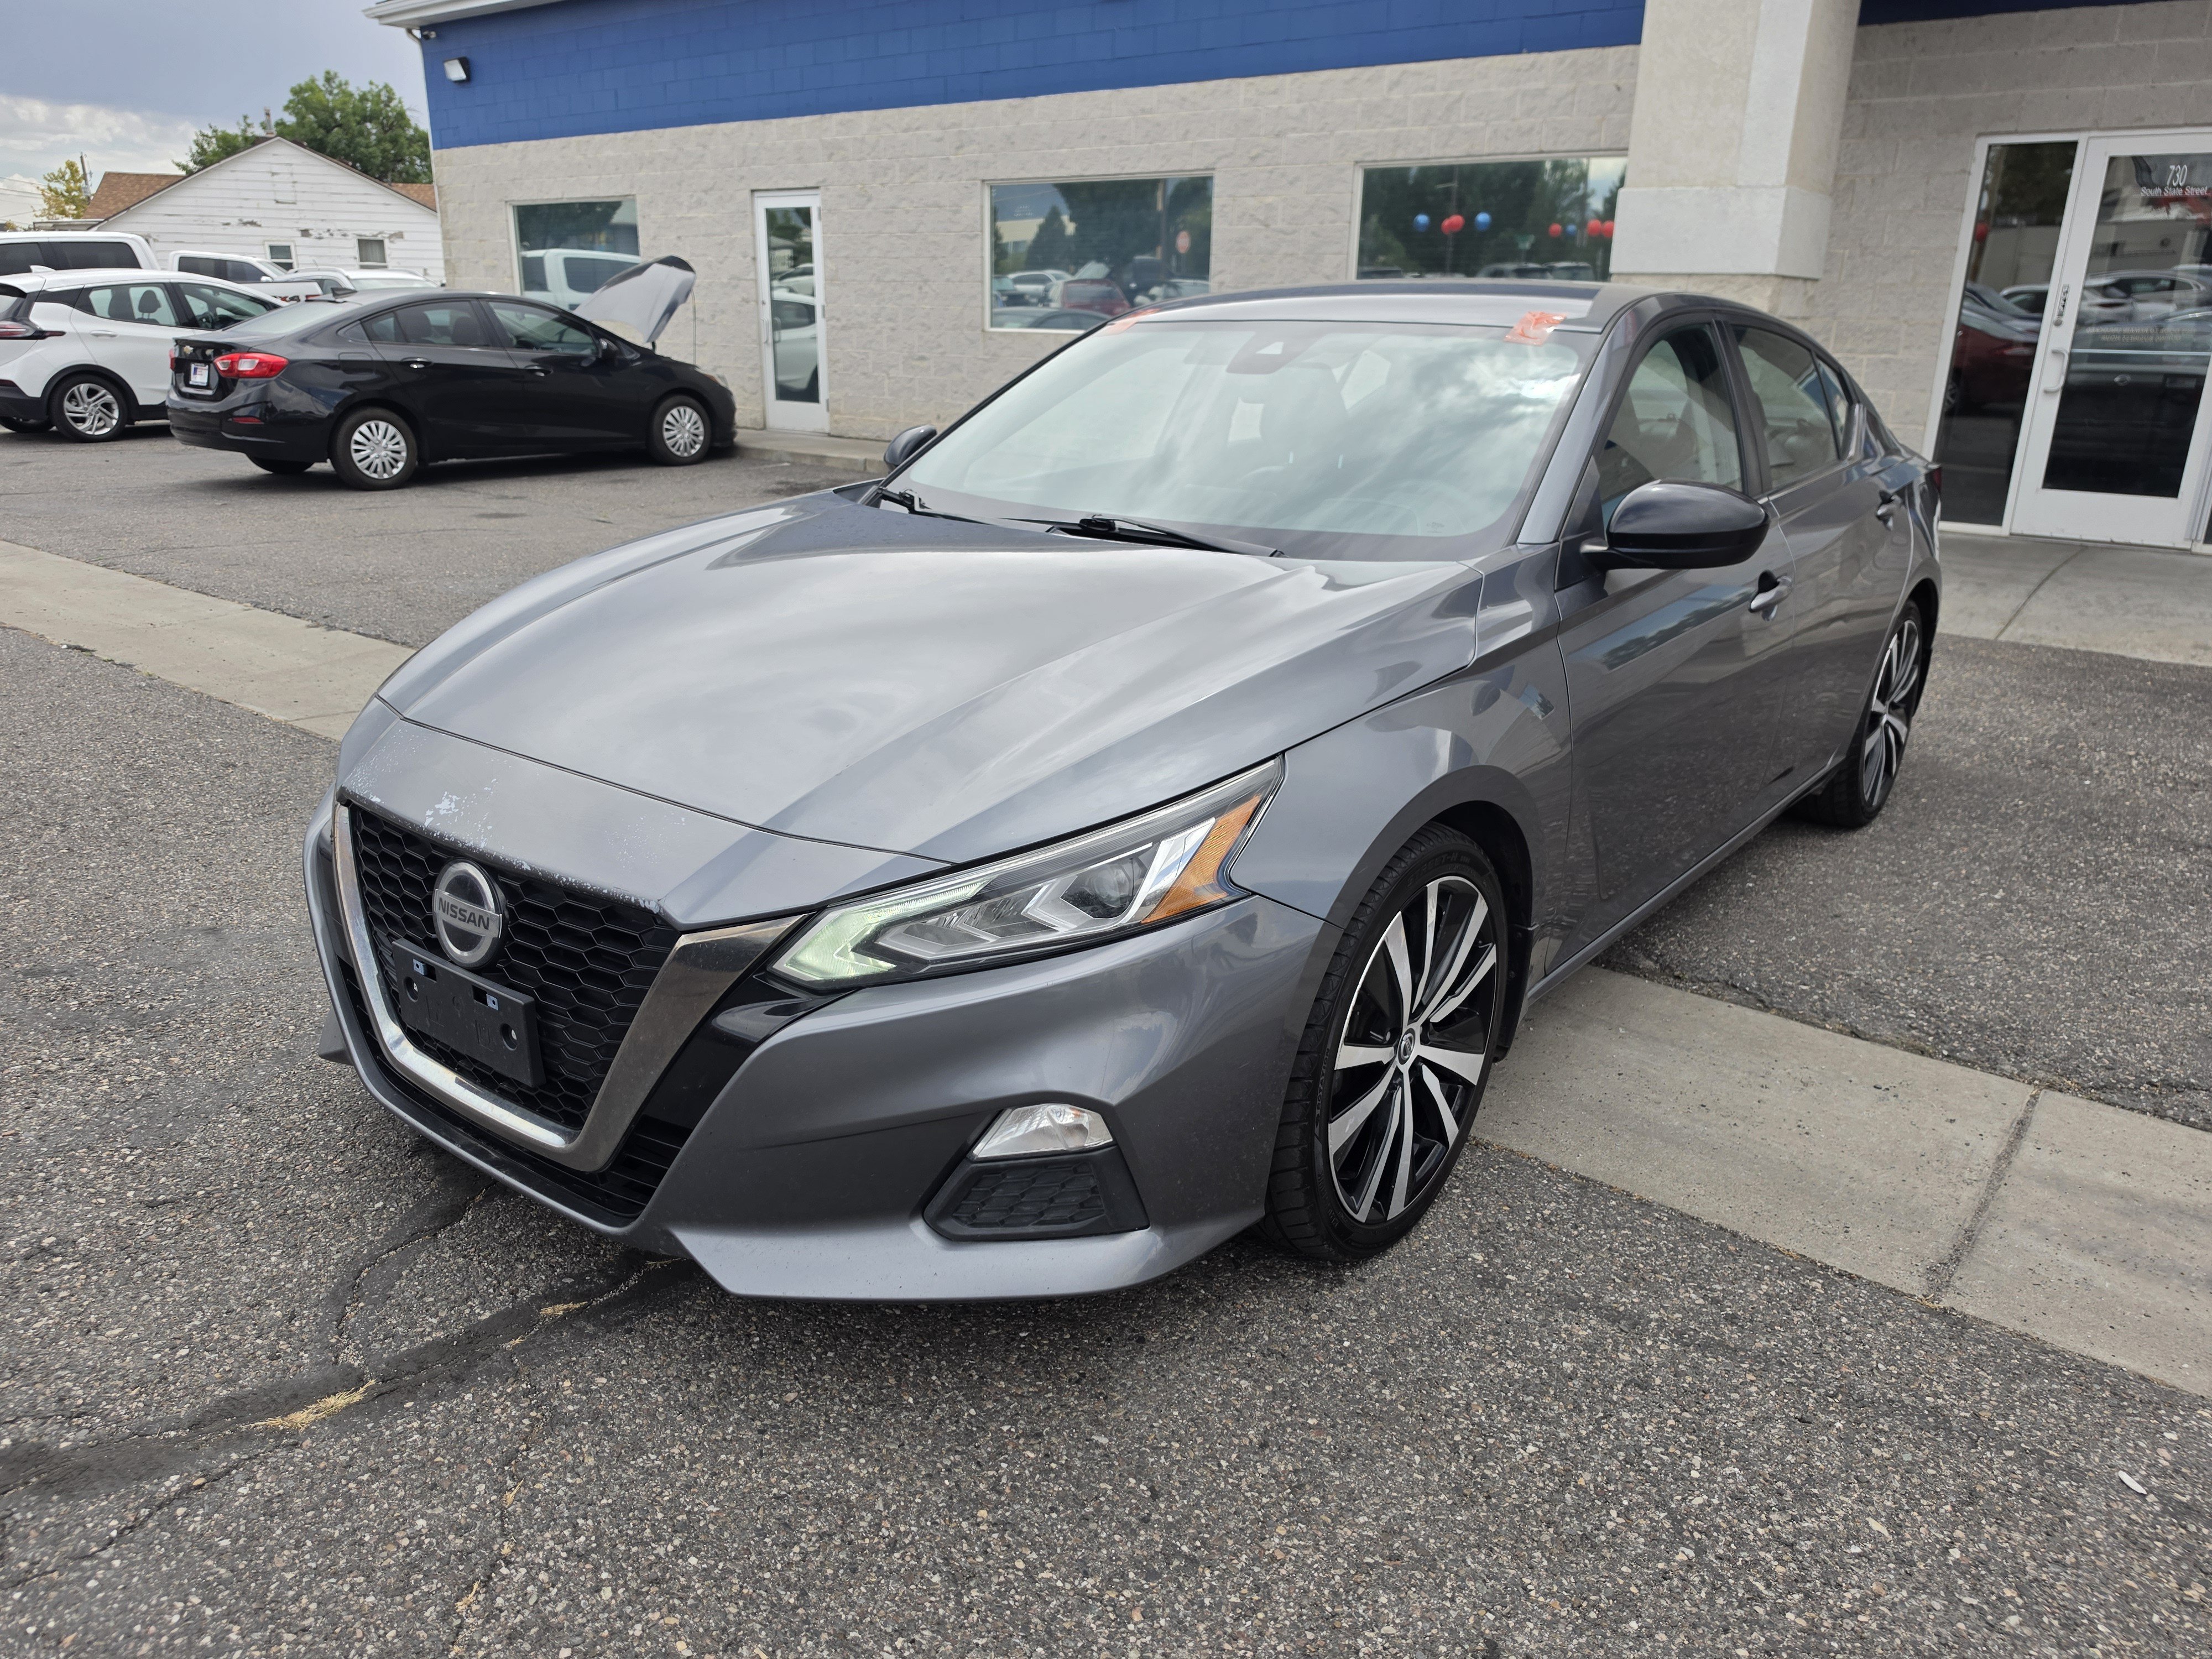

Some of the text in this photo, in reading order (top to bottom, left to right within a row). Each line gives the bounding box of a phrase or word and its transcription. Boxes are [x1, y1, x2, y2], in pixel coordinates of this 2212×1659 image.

[2167, 164, 2188, 187] 730
[2141, 186, 2208, 196] South State Street
[439, 897, 490, 930] NISSAN
[1316, 1048, 1329, 1110] ROTATION
